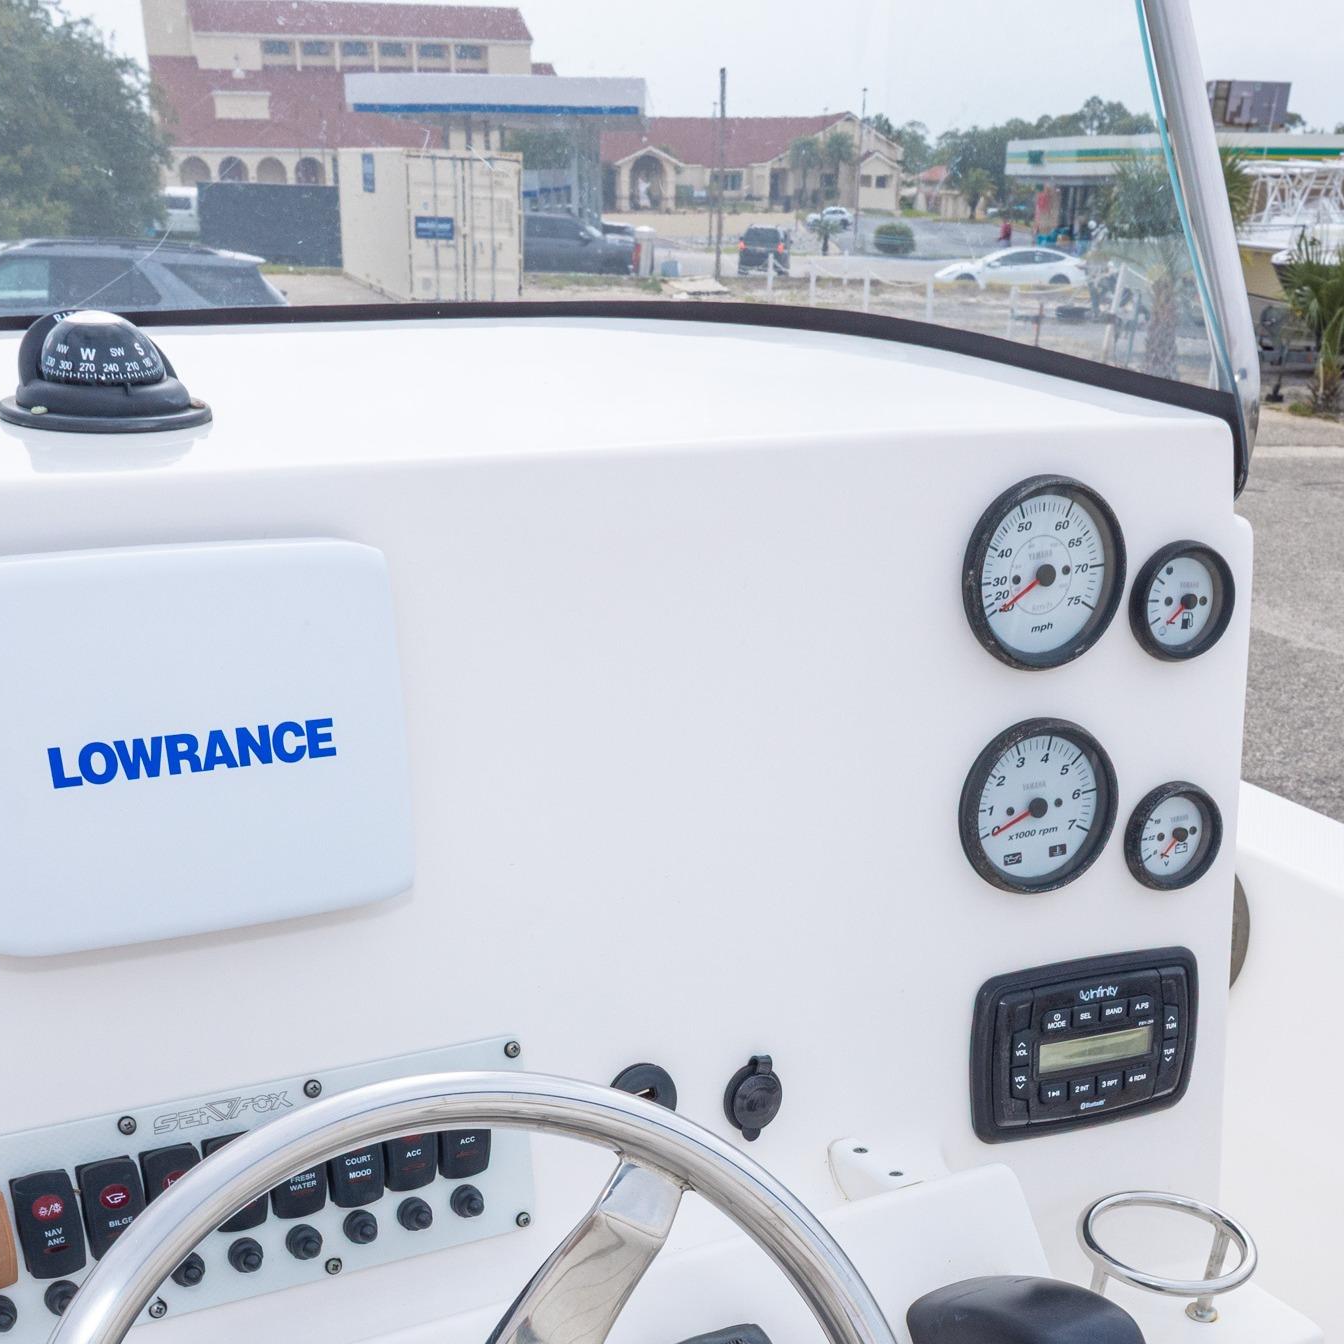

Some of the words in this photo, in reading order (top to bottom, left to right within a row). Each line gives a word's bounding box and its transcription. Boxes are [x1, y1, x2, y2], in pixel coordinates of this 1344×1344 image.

[80, 348, 96, 360] W
[110, 348, 125, 357] SW
[134, 343, 144, 356] S
[59, 361, 72, 371] 300
[80, 363, 96, 372] 270
[103, 363, 119, 372] 240
[126, 362, 140, 371] 210
[1018, 522, 1032, 532] 50
[1055, 520, 1069, 531] 60
[1068, 537, 1082, 548] 65
[998, 548, 1012, 558] 40
[1074, 564, 1088, 574] 70
[993, 576, 1008, 586] 30
[995, 590, 1009, 600] 20
[1068, 596, 1080, 606] 75
[1031, 622, 1053, 634] mph
[47, 718, 337, 789] LOWRANCE
[1041, 753, 1050, 764] 4
[1016, 757, 1025, 768] 3
[1060, 764, 1070, 776] 5
[996, 776, 1006, 786] 2
[1022, 780, 1047, 792] YAMAHA
[1072, 789, 1081, 800] 6
[988, 806, 994, 816] 1
[1068, 819, 1077, 830] 7
[1008, 829, 1036, 841] x1000
[1038, 826, 1058, 836] rpm
[1080, 1012, 1092, 1020] SEL
[1106, 1007, 1122, 1016] BAND
[1048, 1020, 1066, 1030] MODE
[1166, 1022, 1176, 1030] TUN
[1080, 1084, 1090, 1092] INT
[1102, 1080, 1106, 1088] 3
[460, 1136, 476, 1145] ACC
[406, 1149, 422, 1158] ACC
[345, 1154, 374, 1166] COURT.
[290, 1172, 316, 1184] FRESH
[348, 1168, 372, 1179] MOOD
[290, 1180, 317, 1192] WATER
[108, 1216, 134, 1228] BILGE
[44, 1227, 63, 1238] NAV
[47, 1236, 66, 1247] ANC
